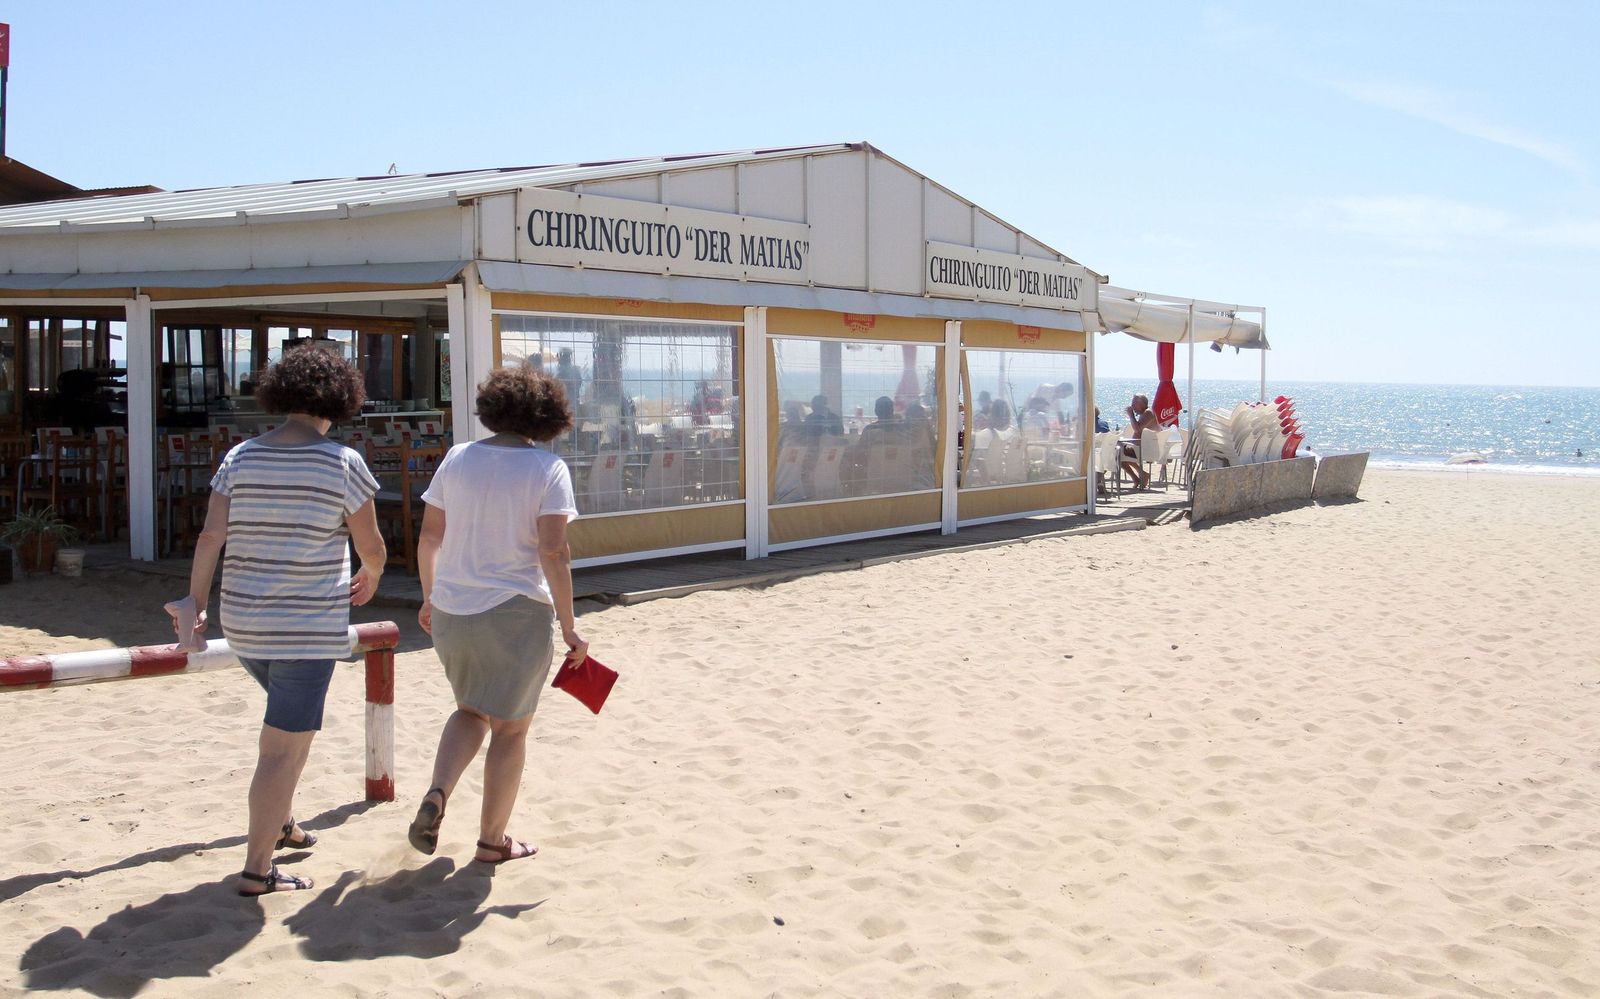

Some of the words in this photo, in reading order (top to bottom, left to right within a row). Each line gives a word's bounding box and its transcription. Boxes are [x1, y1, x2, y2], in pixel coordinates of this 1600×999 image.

[527, 209, 681, 259] CHIRINGUITO
[686, 226, 733, 264] “DER
[739, 233, 810, 271] MATIAS”
[930, 255, 1011, 292] CHIRINGUITO
